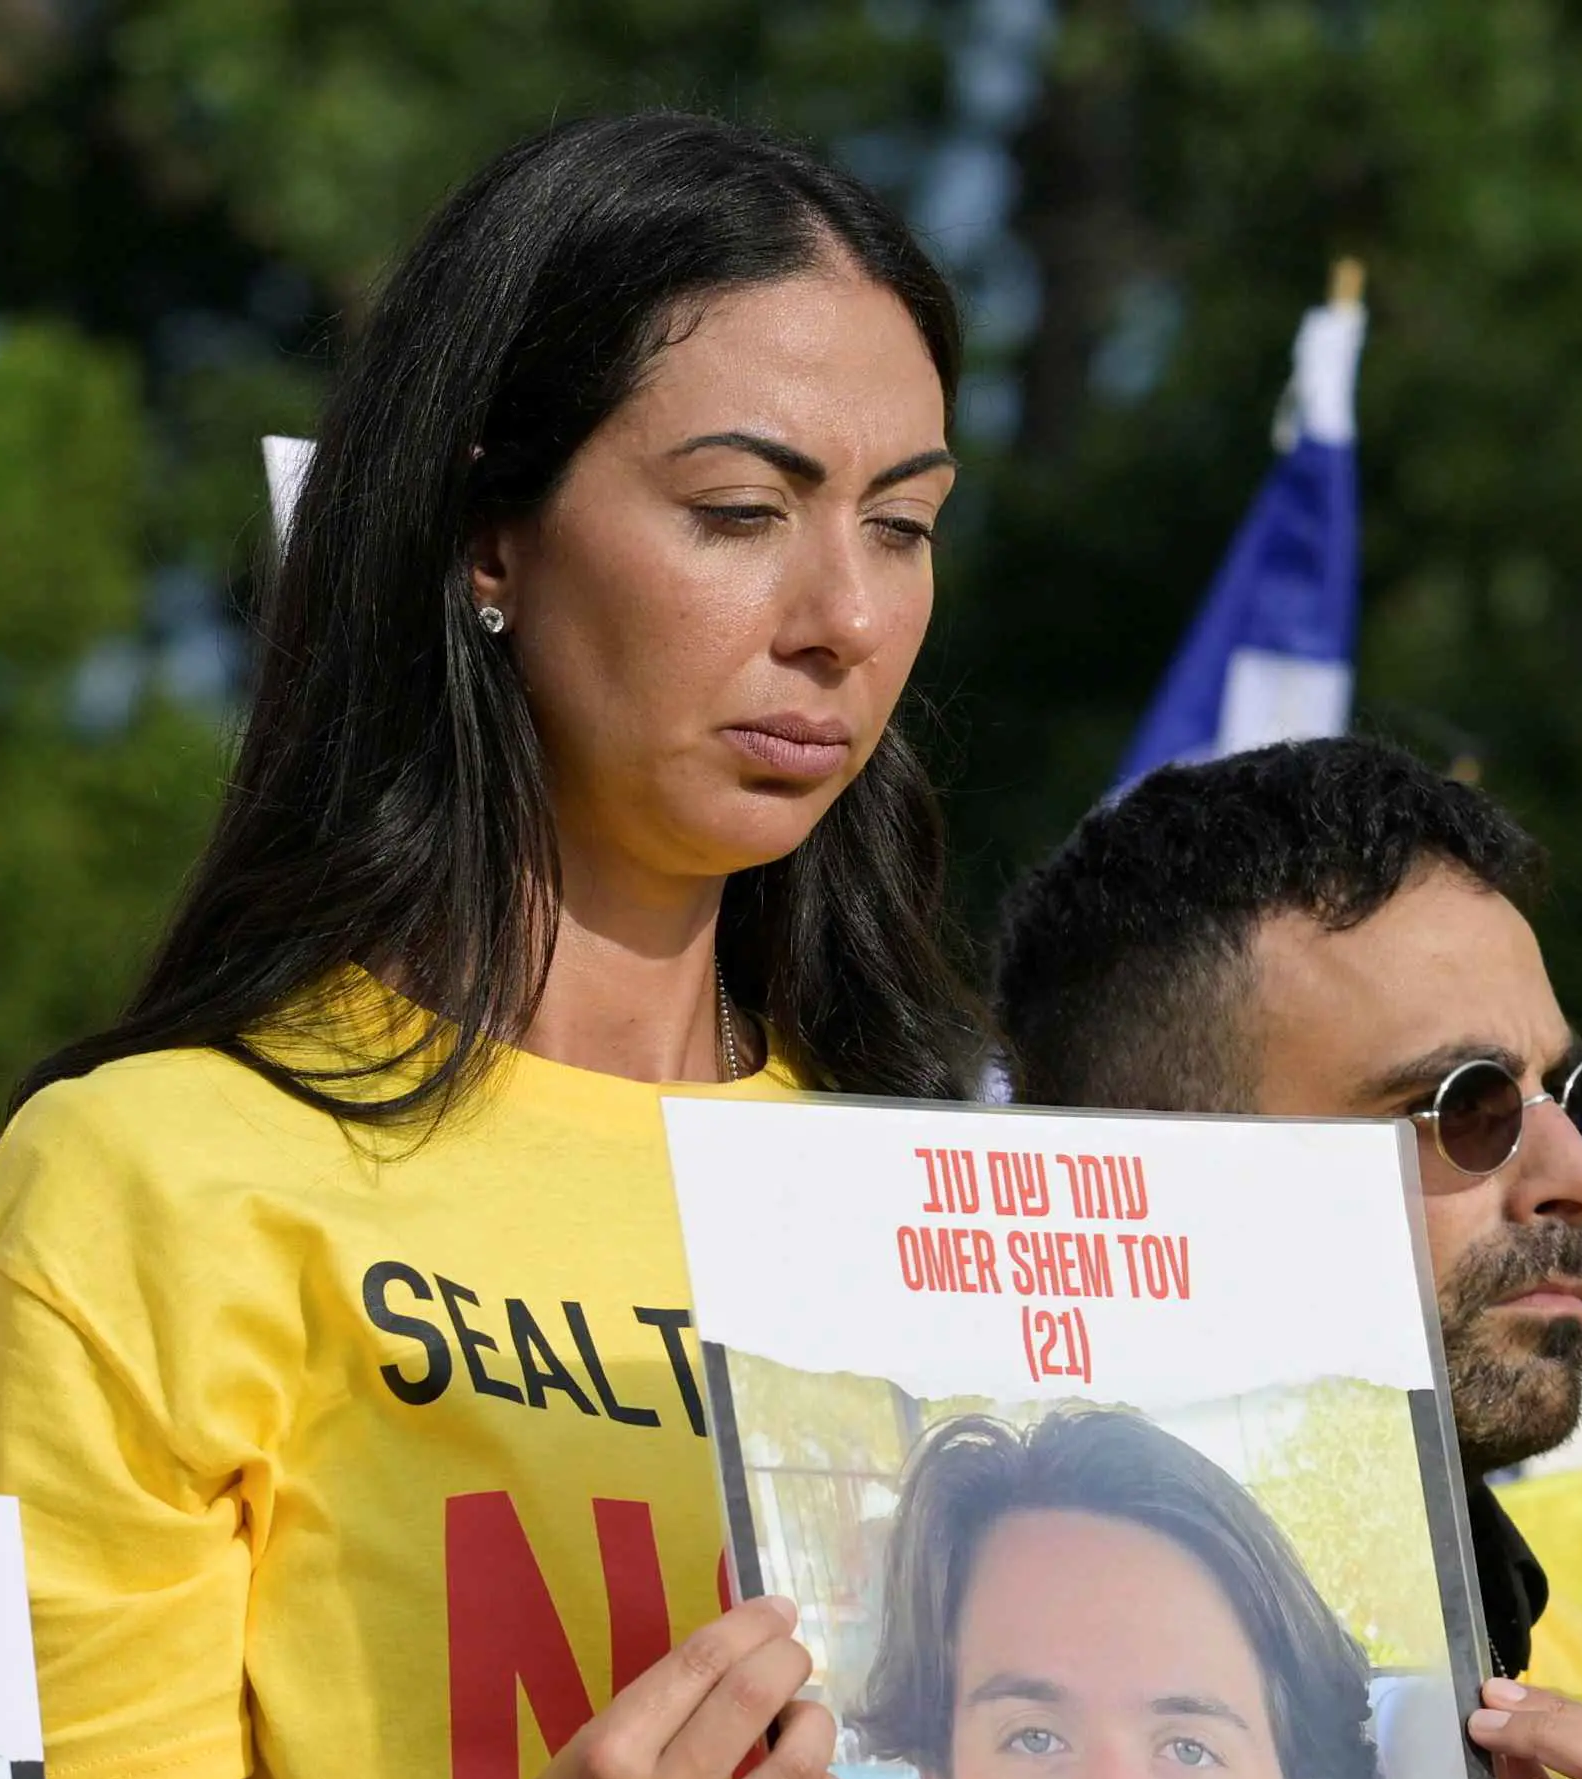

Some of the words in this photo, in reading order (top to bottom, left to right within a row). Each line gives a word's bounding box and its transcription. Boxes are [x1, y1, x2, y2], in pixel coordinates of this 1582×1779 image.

[914, 1148, 980, 1214] טוב
[987, 1151, 1050, 1217] שם
[1055, 1153, 1149, 1221] עומר
[896, 1225, 1002, 1294] OMER
[1008, 1230, 1114, 1298] SHEM
[1117, 1234, 1190, 1300] TOV
[362, 1259, 661, 1429] SEAL
[1022, 1305, 1092, 1383] (21)
